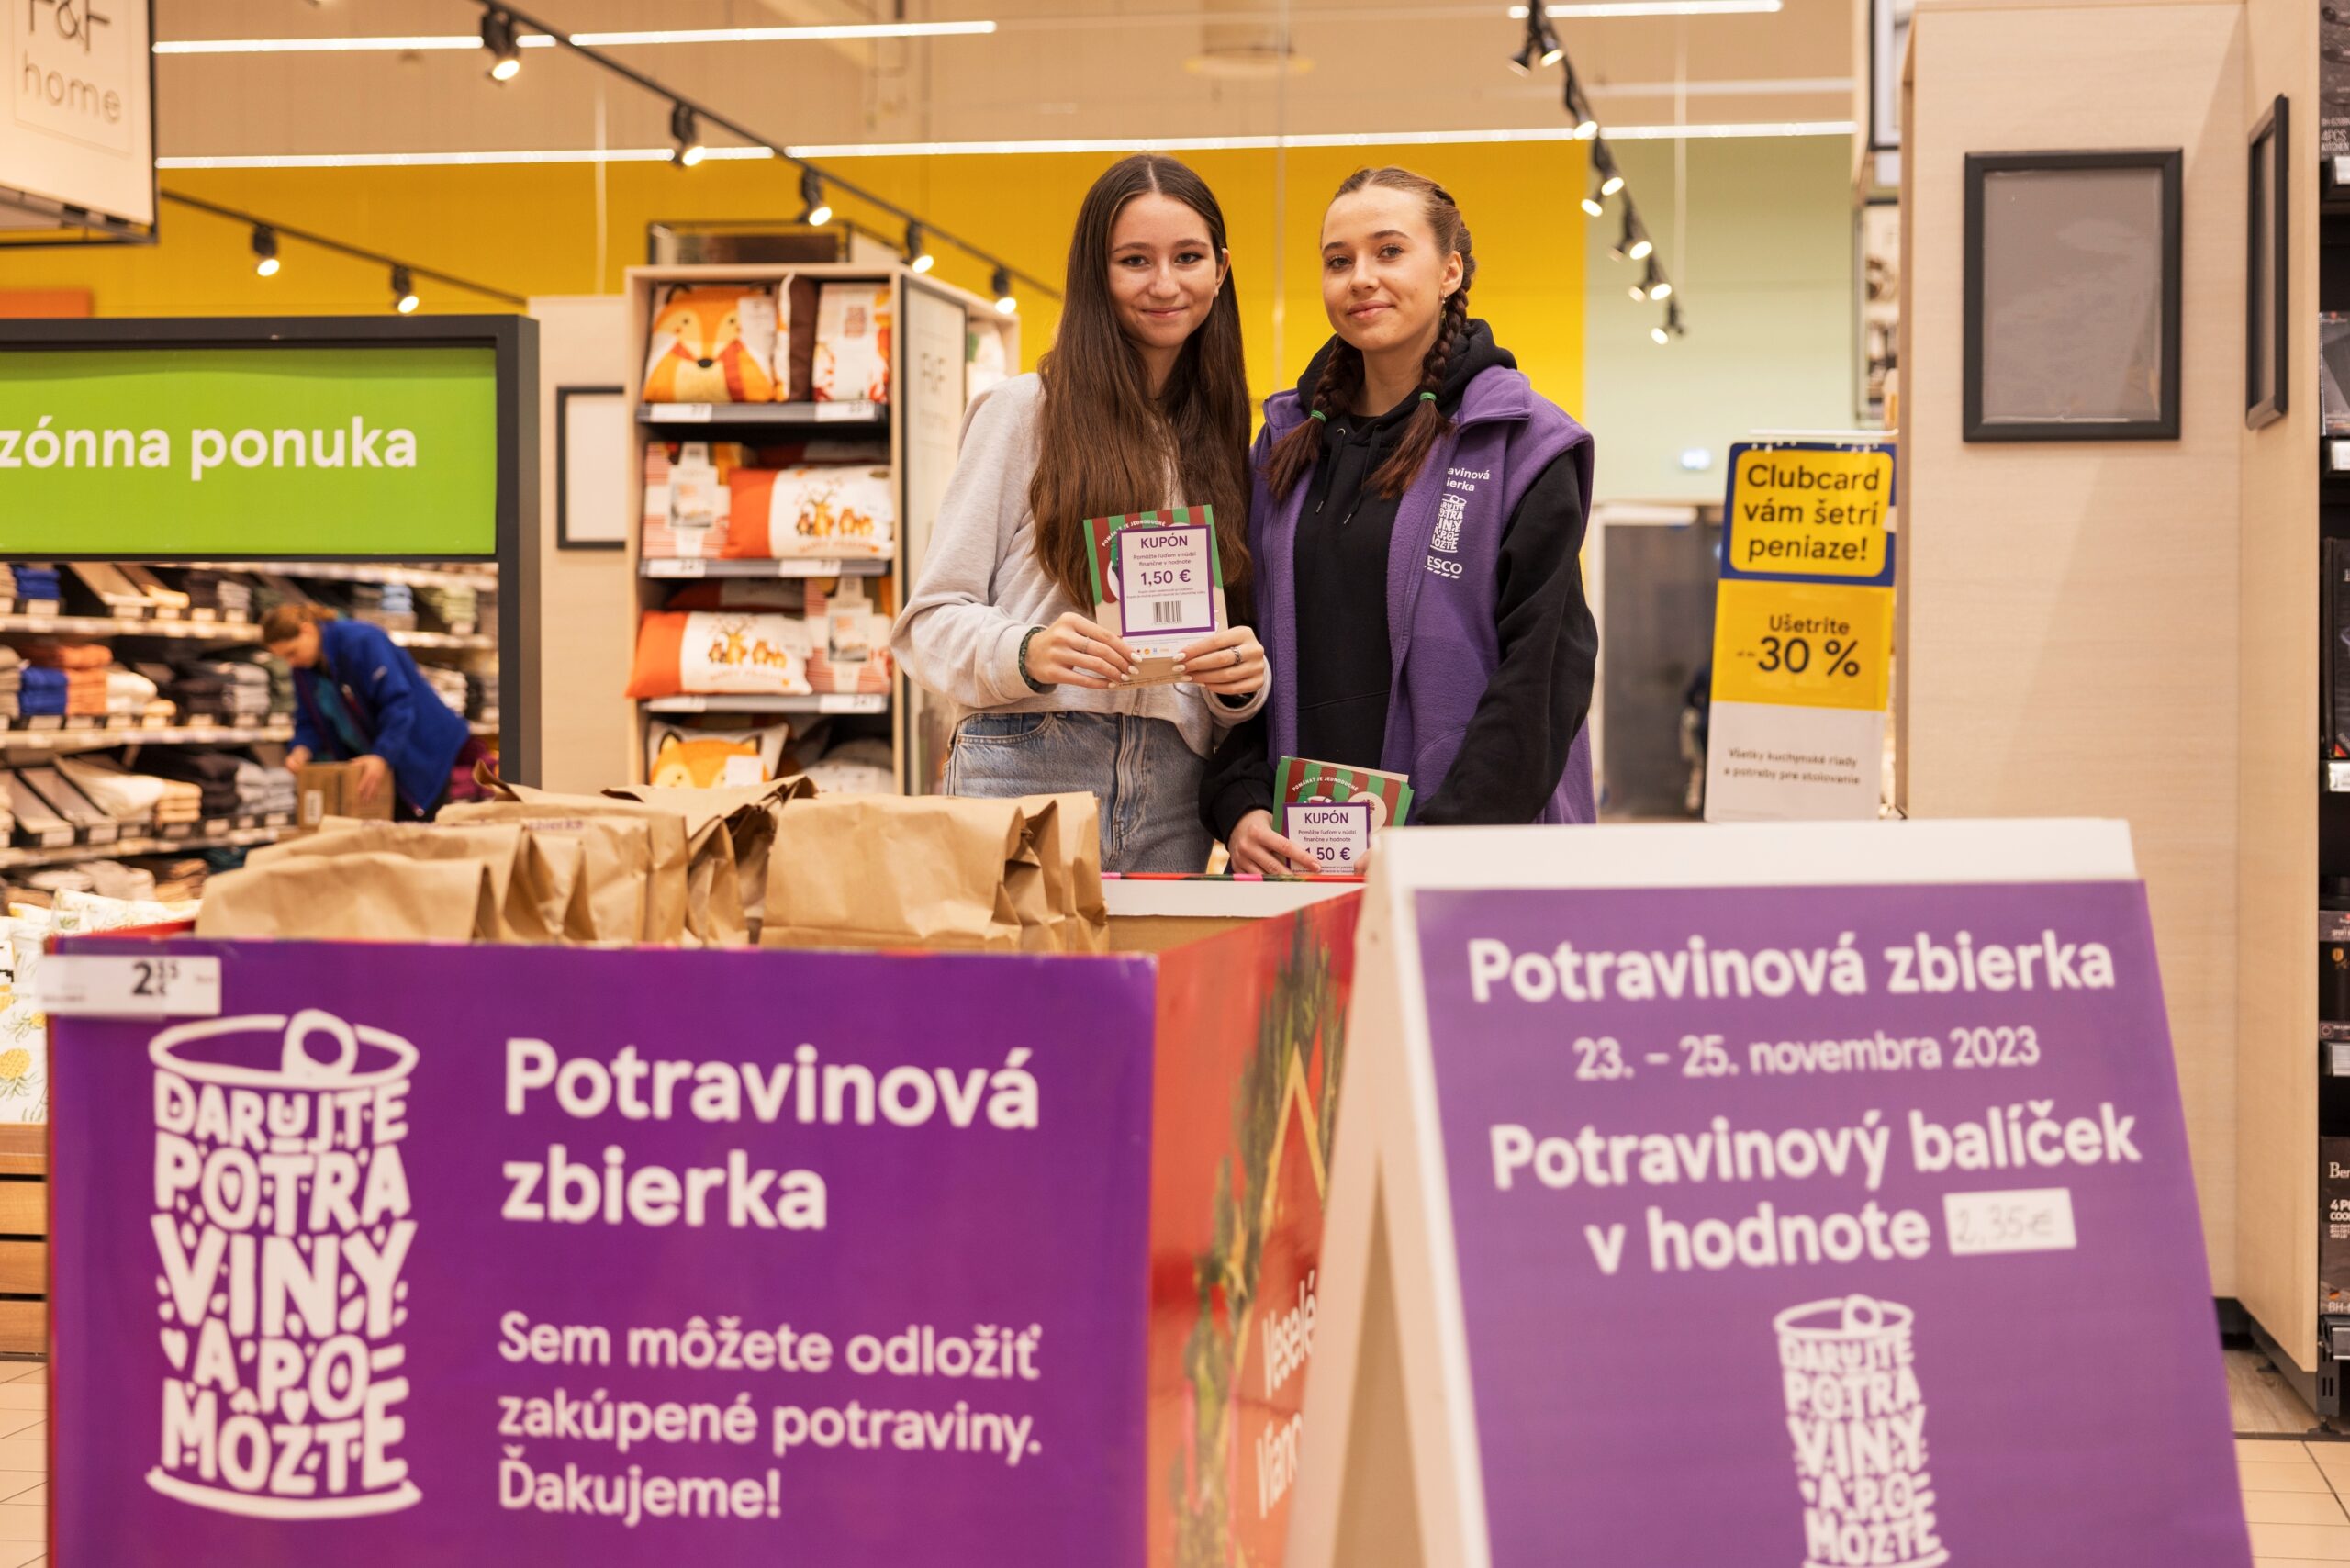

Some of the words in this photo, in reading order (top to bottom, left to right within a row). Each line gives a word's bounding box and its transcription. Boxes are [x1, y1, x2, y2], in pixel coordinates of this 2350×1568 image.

[23, 48, 122, 124] home
[0, 415, 170, 468] zónna
[191, 415, 417, 482] ponuka
[1446, 477, 1475, 492] ierka
[1447, 467, 1490, 480] avinová
[1747, 463, 1880, 491] Clubcard
[1437, 517, 1463, 532] INY
[1441, 501, 1465, 511] RUJTE
[1744, 497, 1804, 523] vám
[1814, 498, 1878, 526] šetrí
[1141, 533, 1188, 549] KUPÓN
[1748, 534, 1867, 563] peniaze!
[1140, 569, 1173, 586] 1,50
[1179, 569, 1191, 583] €
[1427, 555, 1462, 574] ESCO
[1769, 612, 1851, 635] Ušetrite
[1758, 635, 1810, 674] 30
[1824, 639, 1860, 678] %
[1779, 770, 1798, 781] pre
[1304, 810, 1348, 823] KUPÓN
[1305, 847, 1335, 861] 50
[1339, 847, 1350, 861] €
[1468, 931, 1867, 1002] Potravinová
[1884, 929, 2115, 993] zbierka
[1572, 1036, 1634, 1081] 23.
[1679, 1034, 1739, 1077] 25.
[1749, 1030, 1942, 1074] novembra
[1949, 1025, 2041, 1069] 2023
[506, 1038, 1038, 1129] Potravinová
[154, 1069, 410, 1154] DARUJTE
[1490, 1109, 1890, 1191] Potravinový
[1908, 1099, 2142, 1172] balíček
[154, 1129, 412, 1238] POTRA
[501, 1144, 827, 1230] zbierka
[2330, 1211, 2350, 1222] COO
[2340, 1199, 2350, 1212] P
[1585, 1223, 1626, 1274] v
[1646, 1201, 1930, 1271] hodnote
[151, 1213, 418, 1340] VINY
[192, 1316, 240, 1395] A
[498, 1310, 610, 1365] Sem
[628, 1316, 833, 1372] môžete
[845, 1324, 1042, 1380] odložiť
[1262, 1269, 1315, 1399] Veselé
[498, 1388, 758, 1453] zakúpené
[773, 1401, 1041, 1466] potraviny.
[499, 1444, 781, 1527] Ďakujeme!
